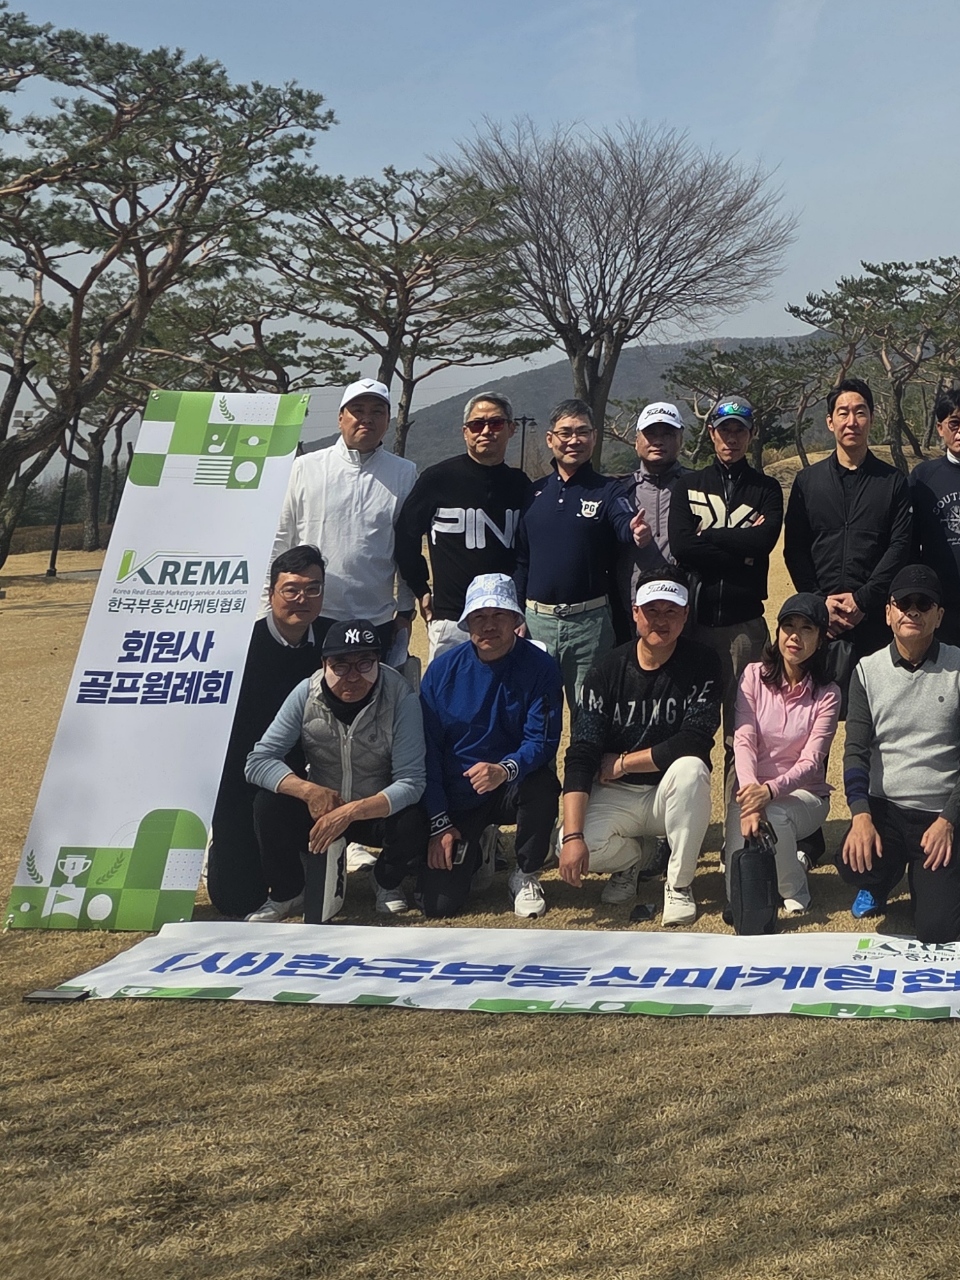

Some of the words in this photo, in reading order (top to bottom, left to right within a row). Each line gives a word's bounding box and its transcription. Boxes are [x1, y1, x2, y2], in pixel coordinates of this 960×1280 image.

[431, 508, 521, 549] PIN
[116, 550, 249, 585] KREMA
[108, 597, 246, 614] 한국부동산마케팅협회
[112, 588, 131, 596] Korea
[132, 588, 145, 596] Real
[166, 589, 195, 597] Marketing
[117, 630, 215, 663] 회원사
[76, 670, 234, 704] 골프월례회
